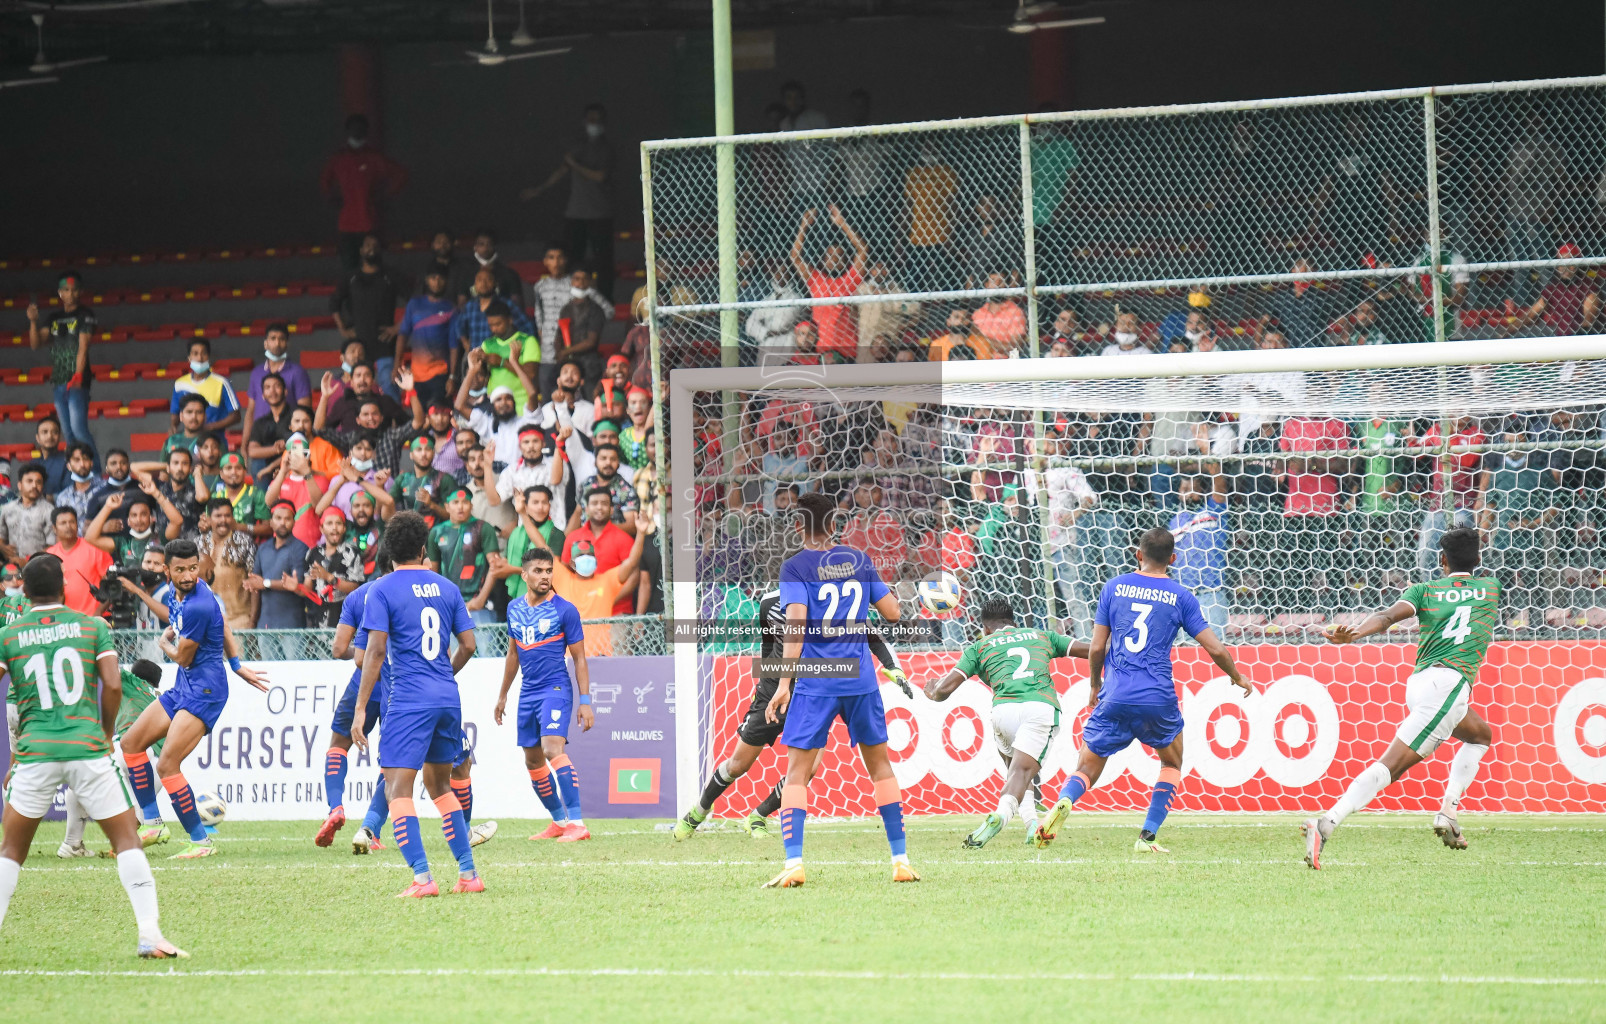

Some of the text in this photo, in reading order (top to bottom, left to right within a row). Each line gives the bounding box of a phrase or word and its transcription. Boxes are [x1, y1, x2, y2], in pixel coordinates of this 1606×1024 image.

[412, 583, 441, 598] GLAN
[1114, 583, 1178, 607] SUBHASISH
[1435, 587, 1487, 603] TOPU
[818, 579, 865, 638] 22
[17, 622, 82, 649] MAHBUBUR
[420, 606, 441, 661] 8
[1124, 602, 1153, 653] 3
[1441, 605, 1473, 645] 4
[988, 630, 1038, 649] YEASIN
[1006, 646, 1035, 680] 2
[23, 646, 86, 710] 10
[637, 706, 649, 714] CUT
[197, 725, 319, 770] JERSEY
[611, 730, 664, 741] IN MALDIVES
[217, 783, 243, 804] FOR
[252, 783, 287, 803] SAFF
